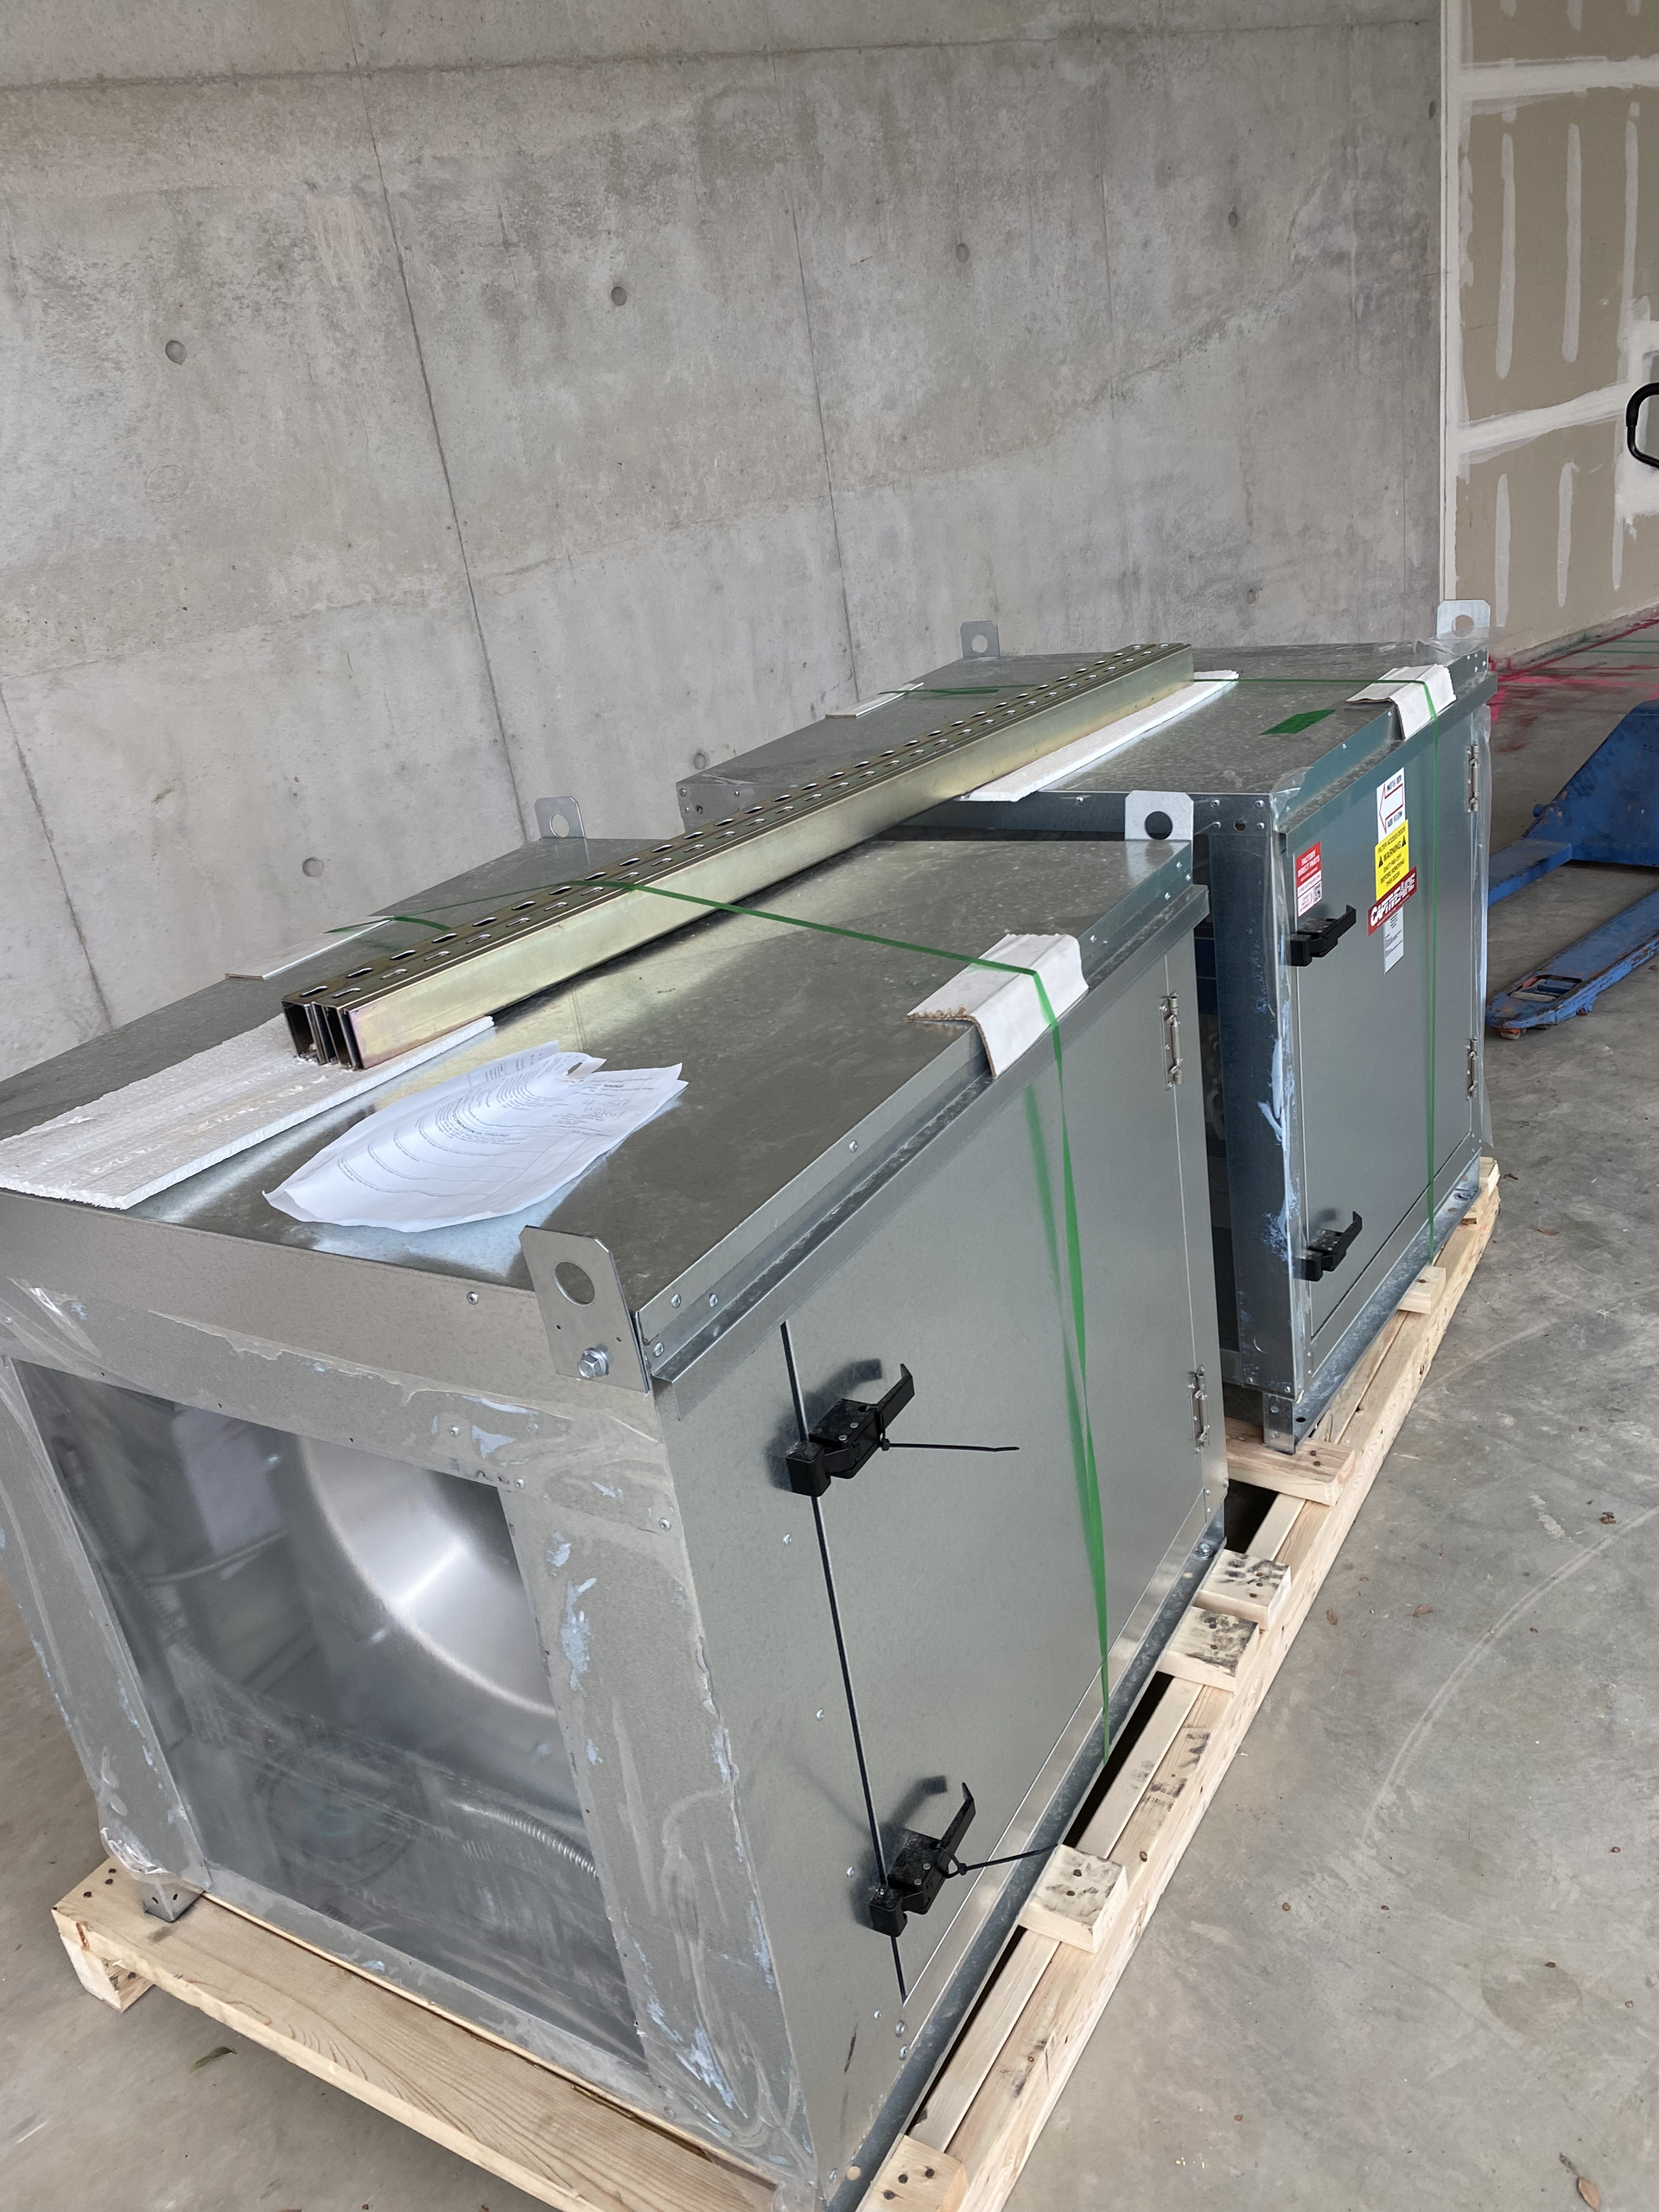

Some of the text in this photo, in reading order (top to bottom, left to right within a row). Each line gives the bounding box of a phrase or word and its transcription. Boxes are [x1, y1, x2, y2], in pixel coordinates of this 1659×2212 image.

[1387, 779, 1395, 791] FLOW
[1393, 810, 1402, 823] FLOW
[1301, 850, 1315, 866] FACTORY
[1383, 840, 1401, 861] WARNING
[452, 1112, 476, 1134] DOMINION
